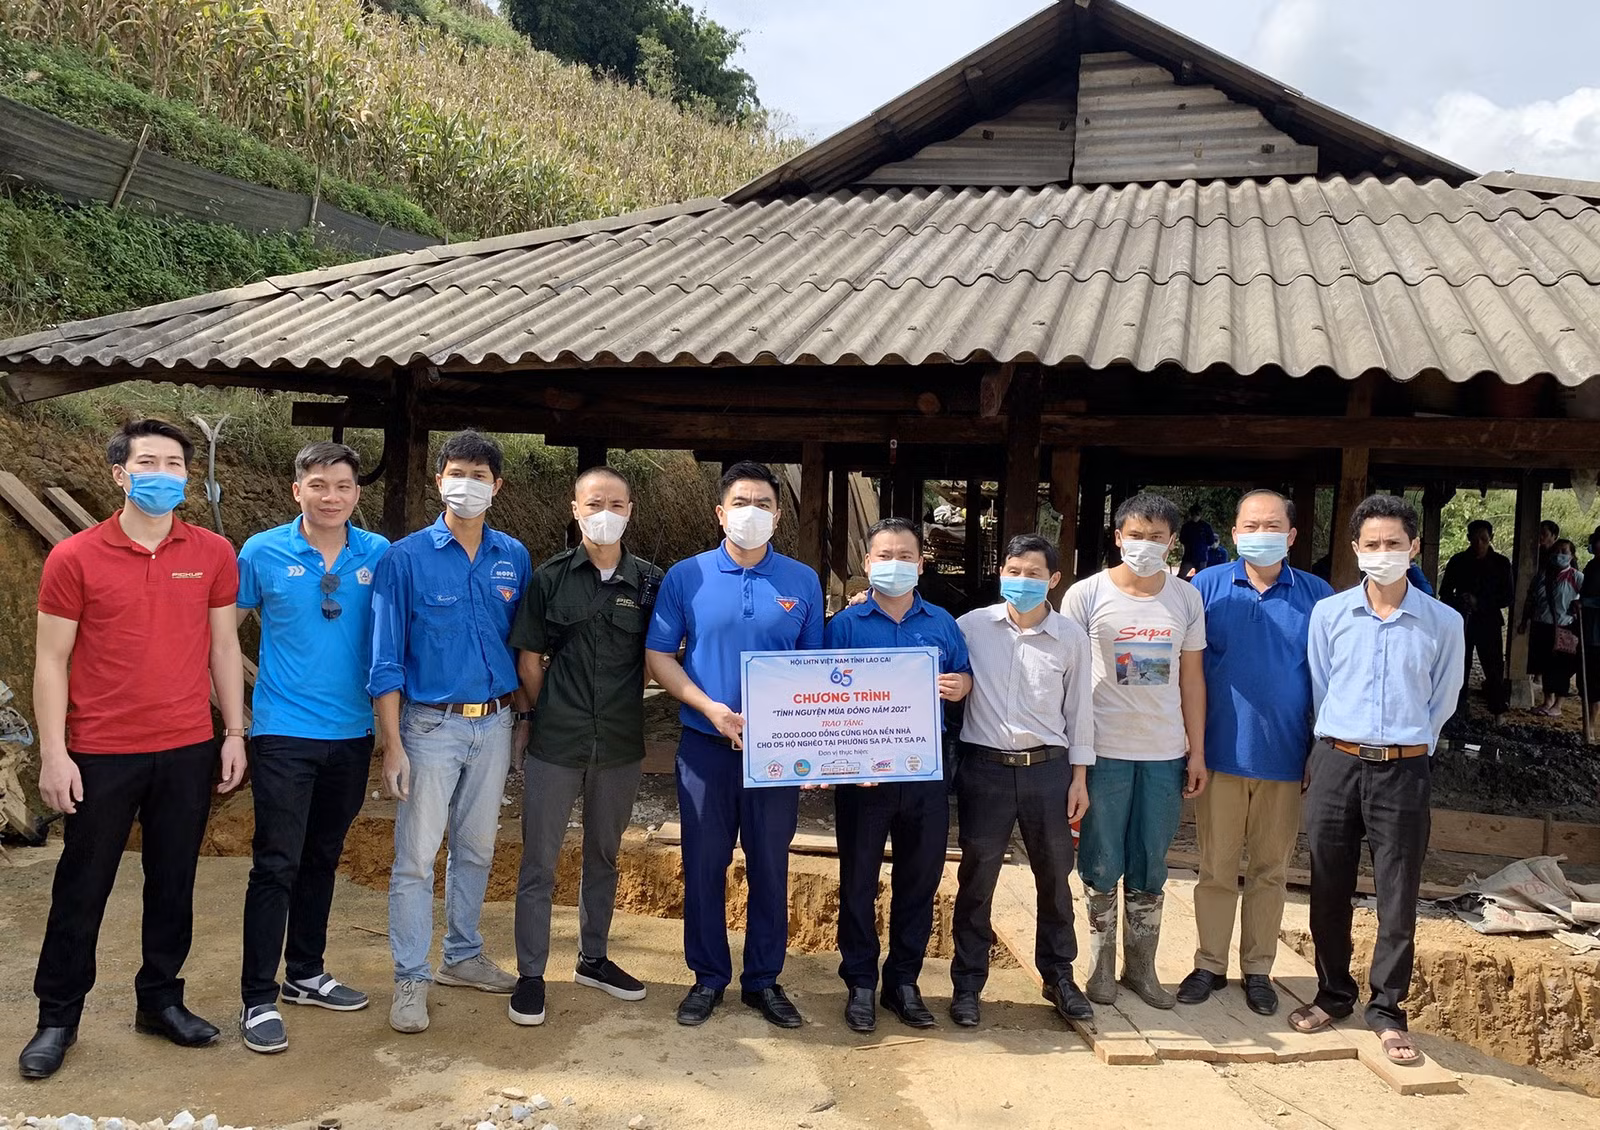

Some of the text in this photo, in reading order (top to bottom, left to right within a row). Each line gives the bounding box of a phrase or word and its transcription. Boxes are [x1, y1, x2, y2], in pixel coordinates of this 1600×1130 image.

[1113, 626, 1172, 641] Sapa
[820, 657, 833, 666] VIỆT
[830, 667, 853, 687] 65
[793, 689, 890, 704] CHƯƠNG TRÌNH
[795, 707, 826, 717] NGUYỆN
[828, 706, 845, 715] MÙA
[847, 706, 870, 715] ĐÔNG
[872, 705, 889, 714] NĂM
[843, 719, 863, 728] TẶNG
[772, 726, 911, 739] 20.000.000 ĐỒNG CỨNG HÓA NỀN NHÀ
[757, 741, 772, 749] CHO
[785, 740, 796, 748] HỘ
[797, 739, 823, 747] NGHÈO
[824, 739, 836, 747] TẠI
[837, 738, 868, 746] PHƯỜNG
[869, 737, 880, 745] SA
[904, 736, 915, 744] SA
